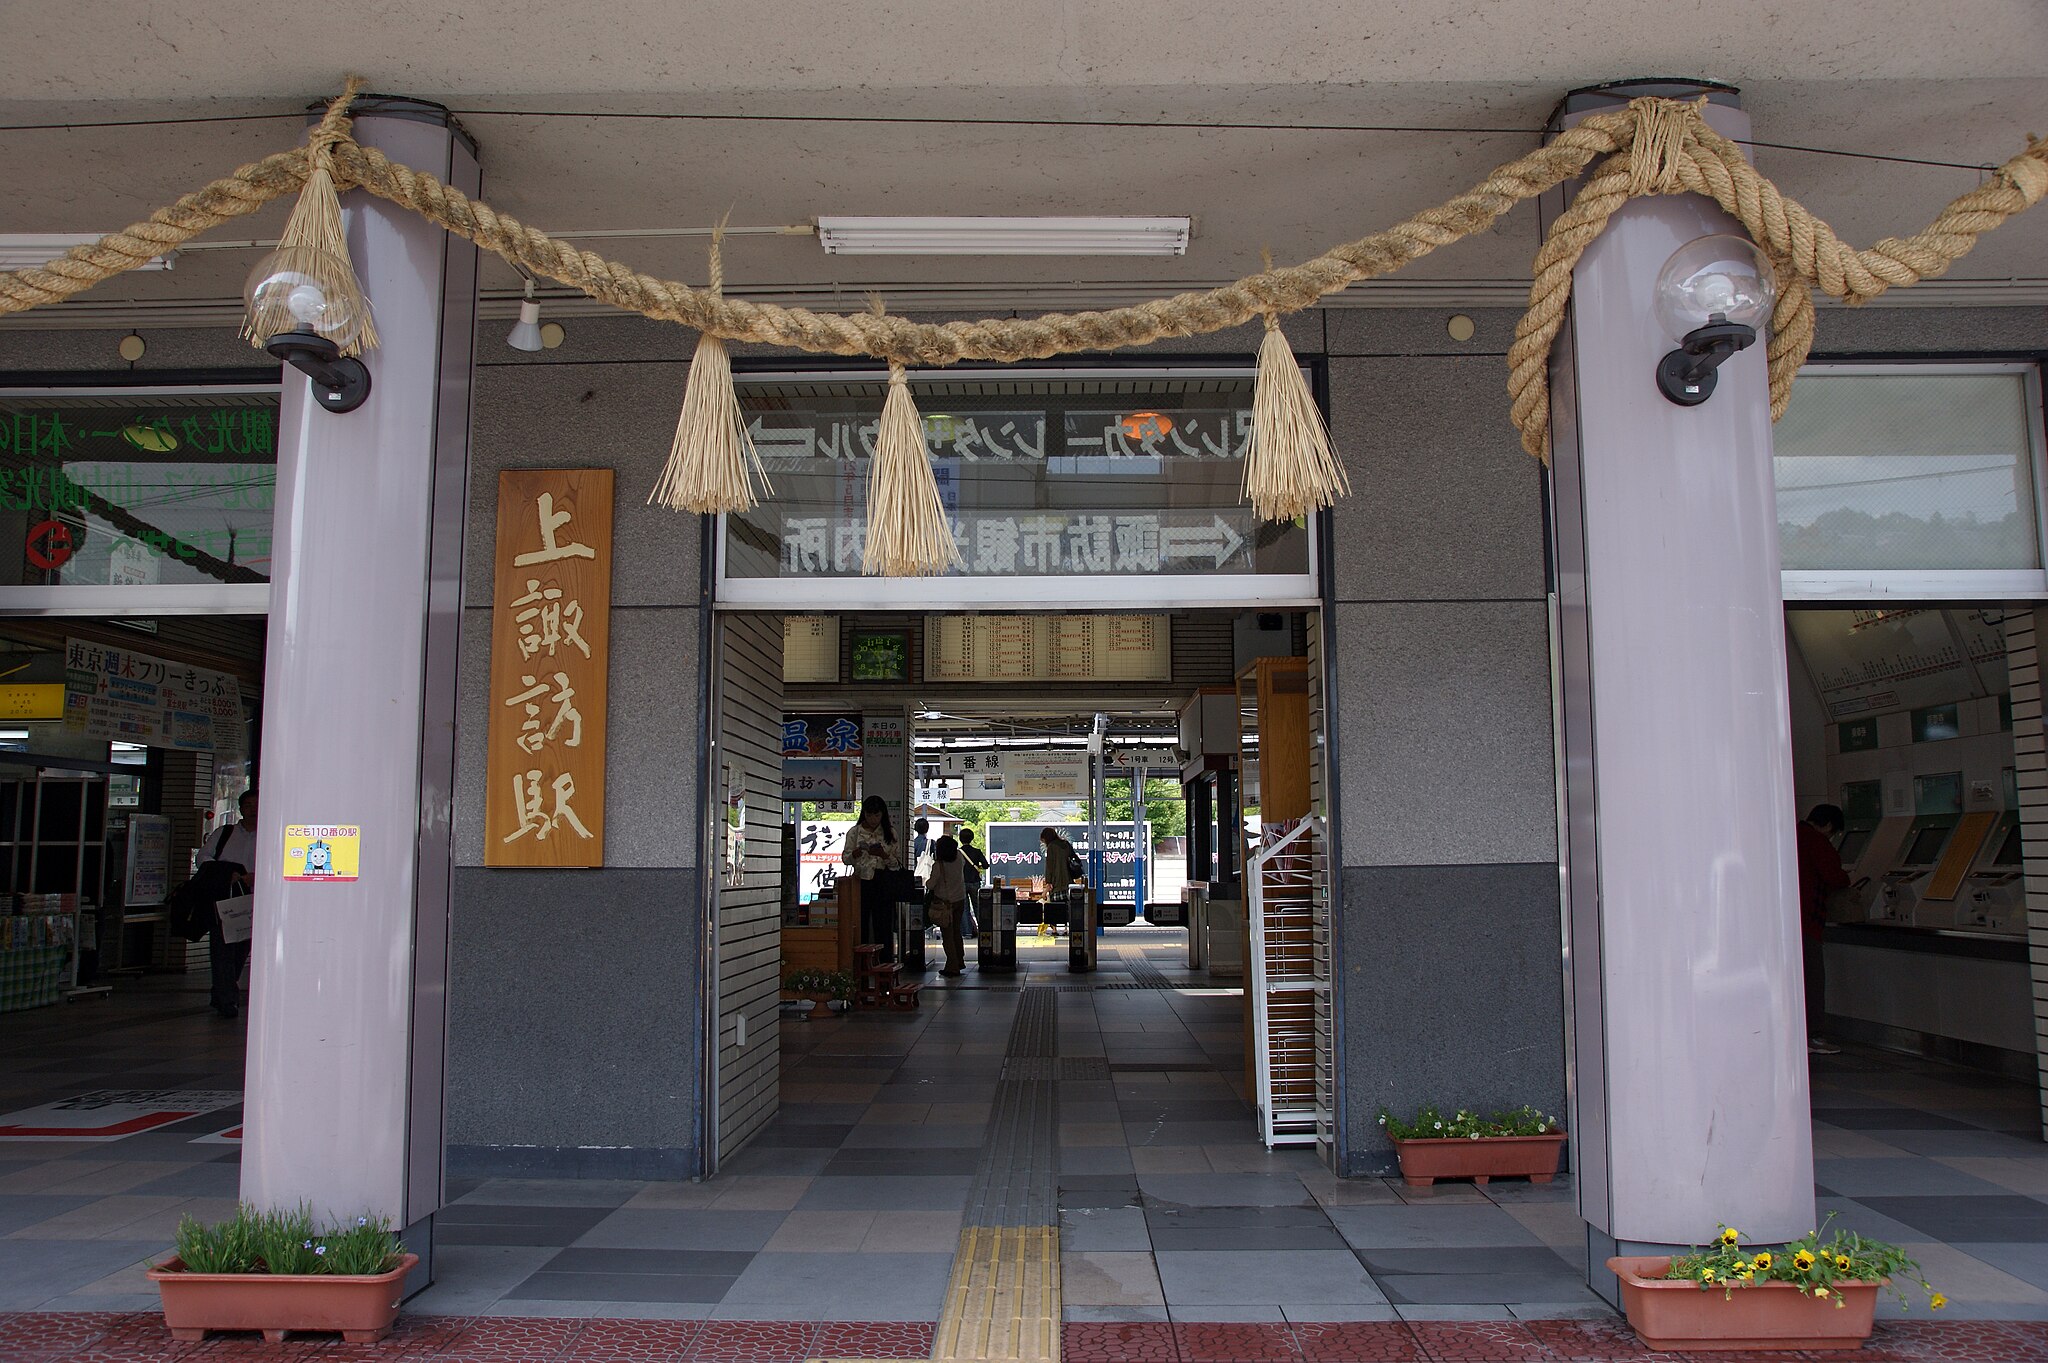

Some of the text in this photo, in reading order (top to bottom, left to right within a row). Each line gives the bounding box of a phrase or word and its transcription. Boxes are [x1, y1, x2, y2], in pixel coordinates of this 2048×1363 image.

[67, 643, 225, 697] 東京週末フリーきっぷ
[503, 491, 596, 844] 上諏訪駅
[945, 755, 1000, 770] 1番線
[287, 827, 358, 837] こども110番の駅
[990, 851, 1042, 865] サマーナイト
